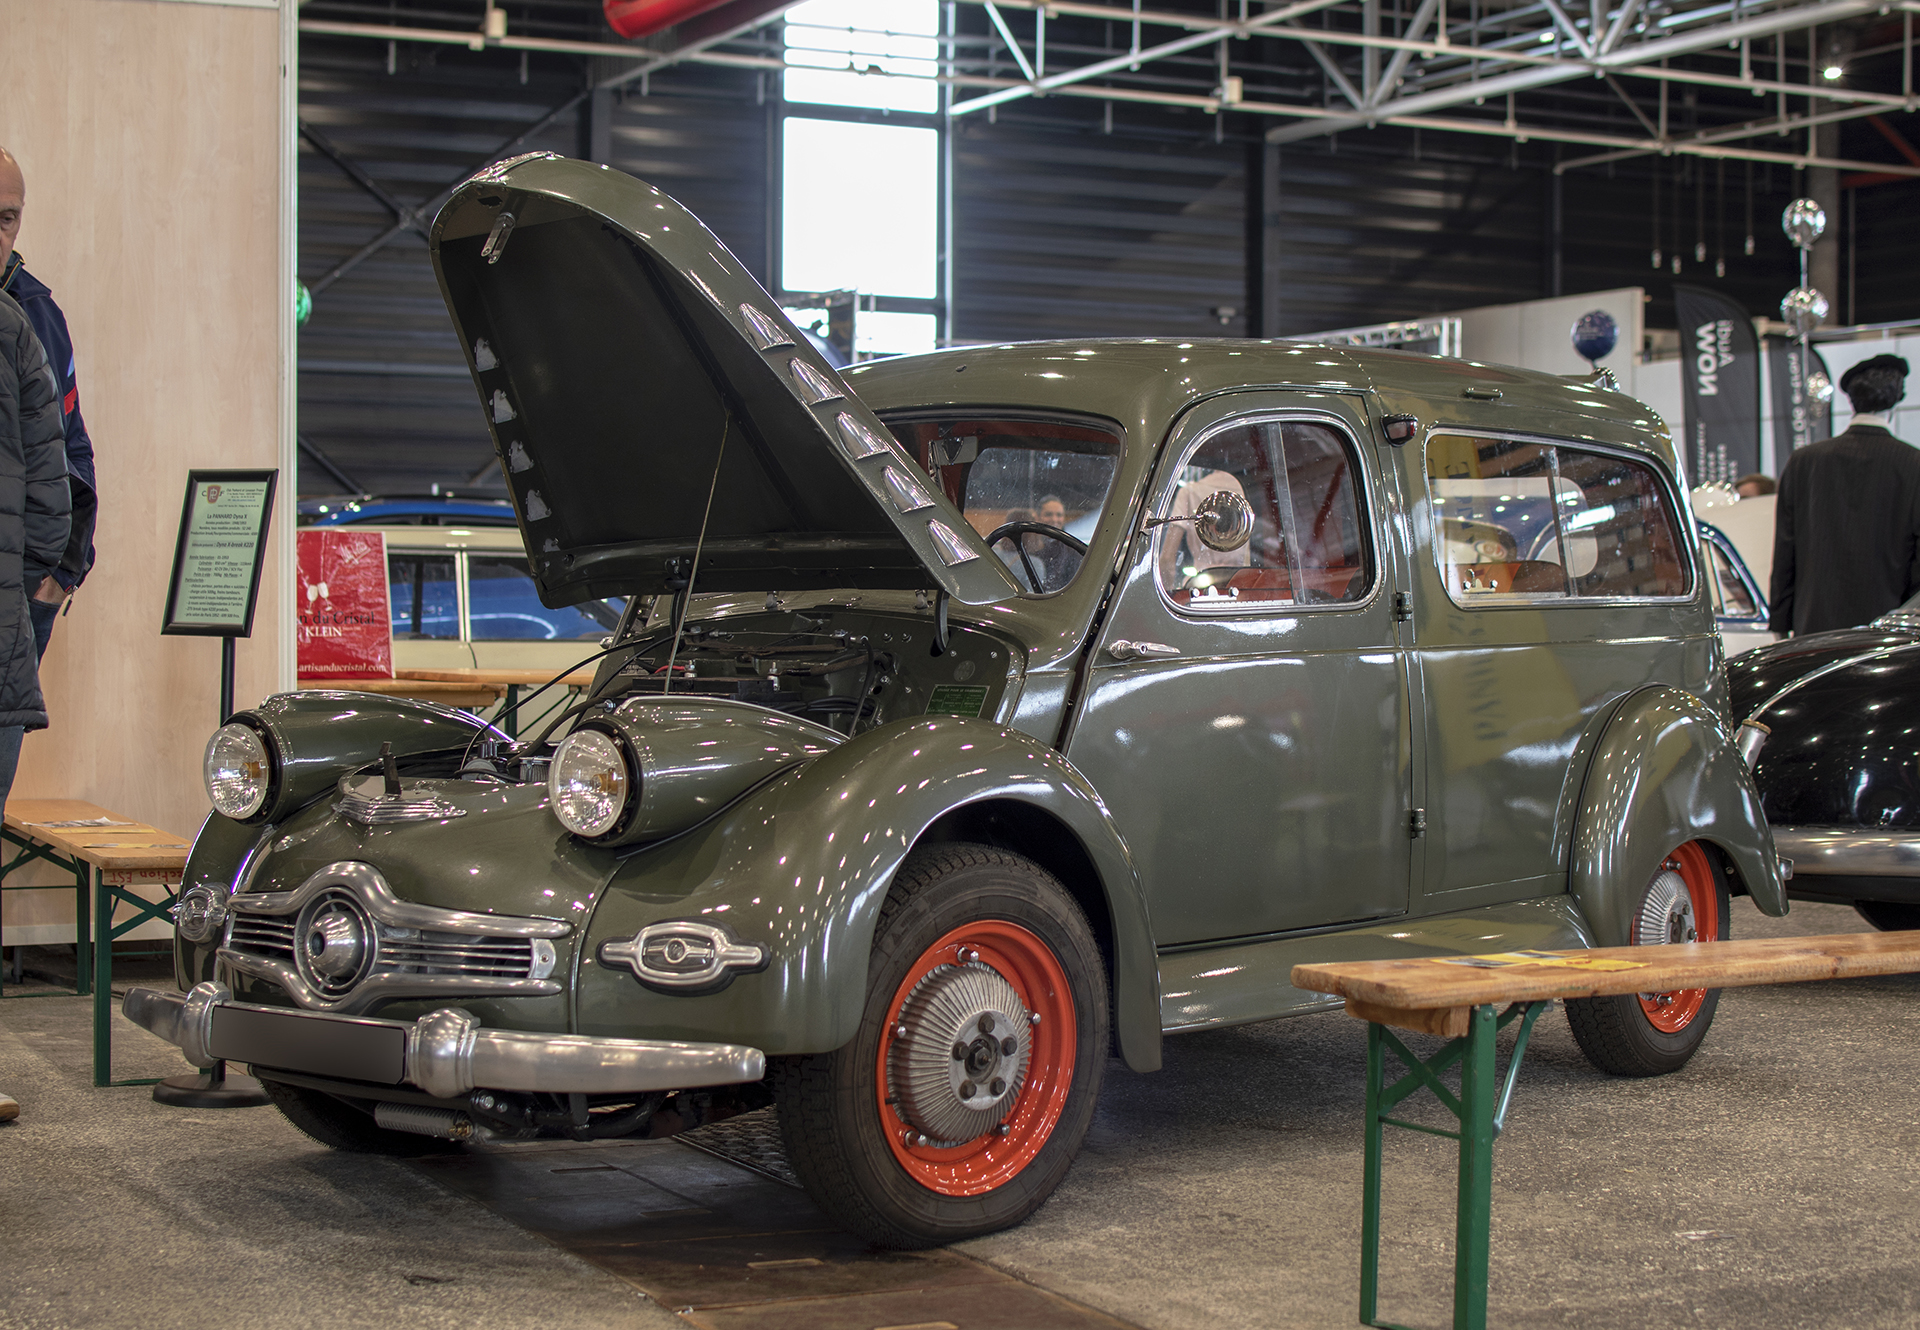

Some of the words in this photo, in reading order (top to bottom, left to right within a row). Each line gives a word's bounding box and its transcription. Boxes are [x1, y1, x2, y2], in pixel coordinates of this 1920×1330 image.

[313, 611, 329, 624] du
[333, 611, 374, 624] Cristal
[306, 626, 342, 637] KLEIN
[110, 870, 132, 883] EST
